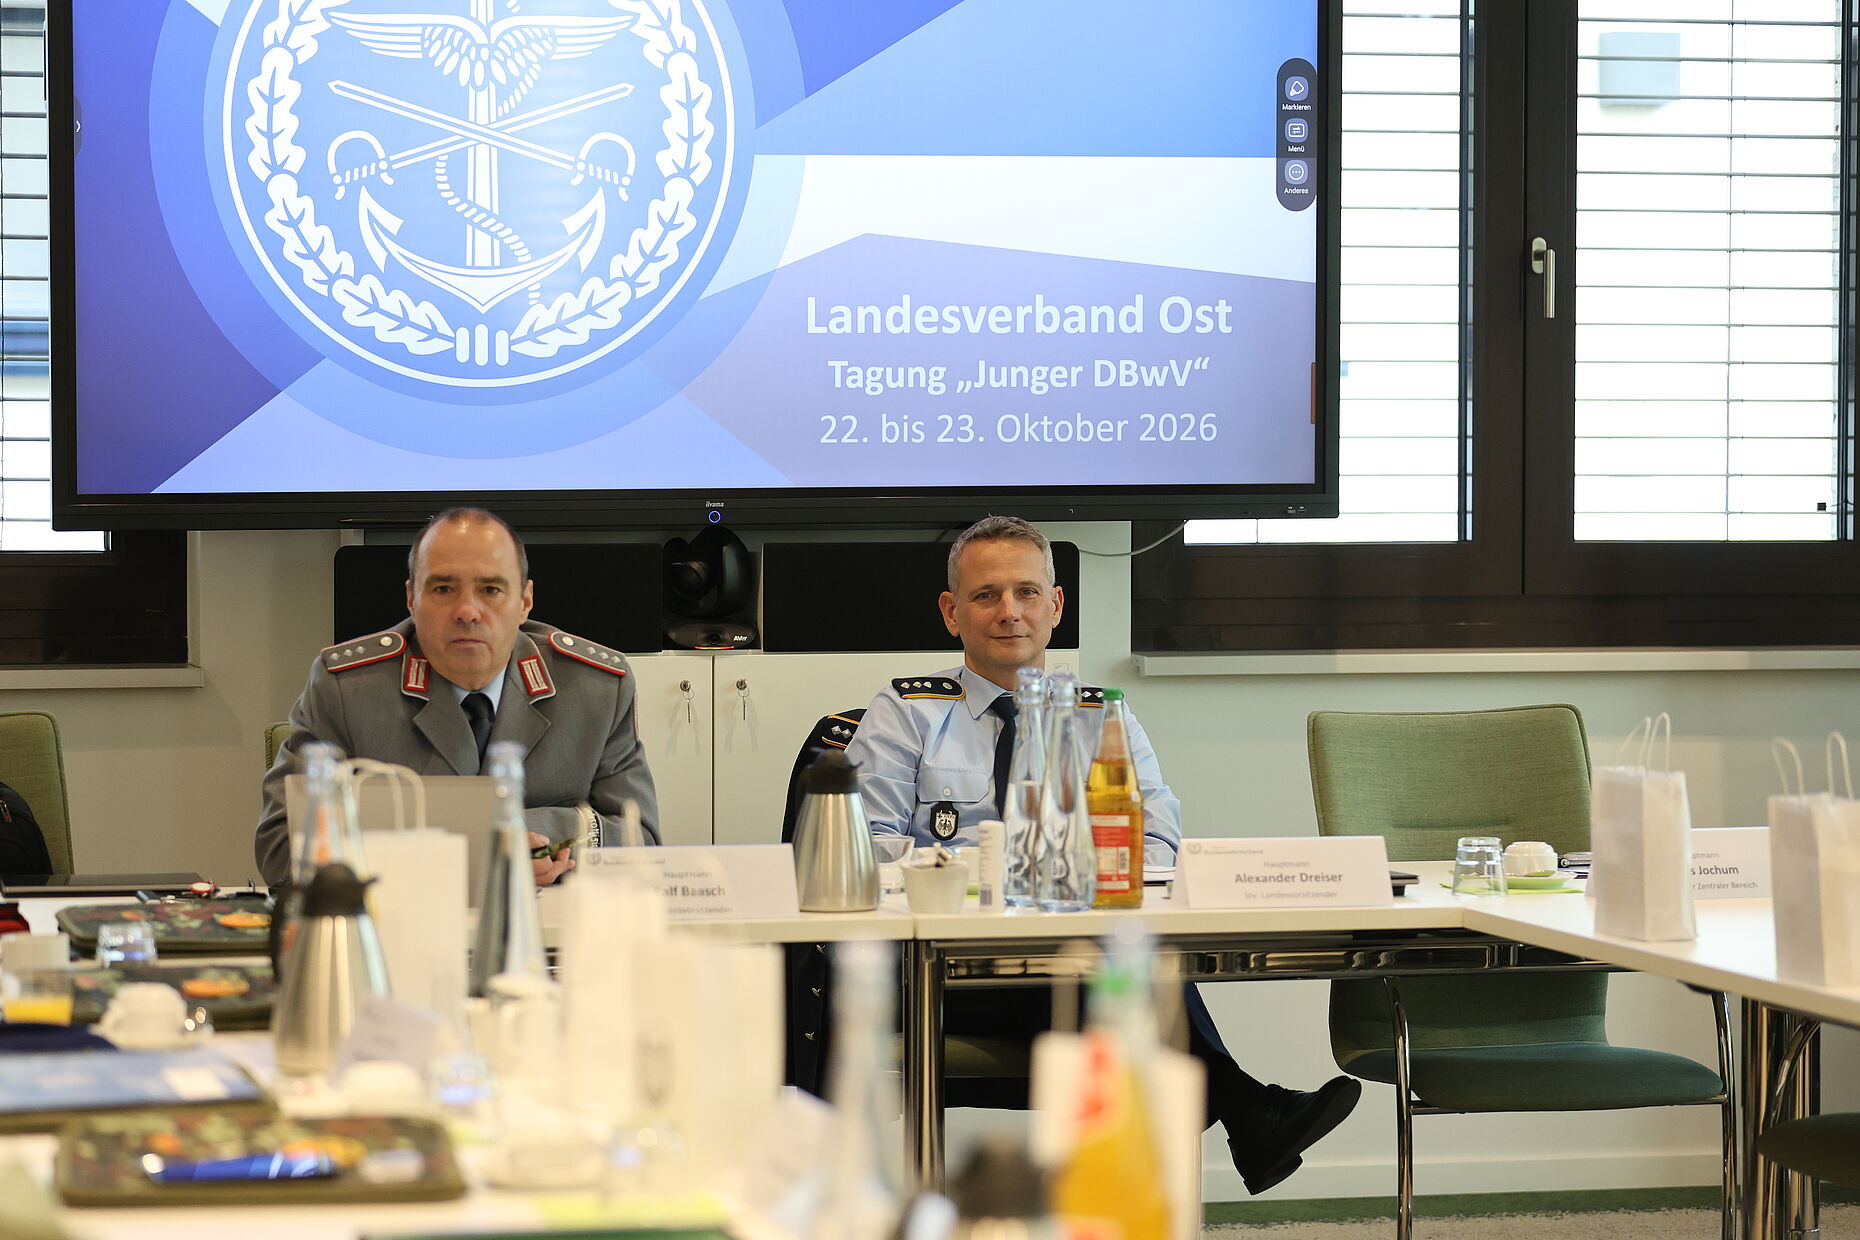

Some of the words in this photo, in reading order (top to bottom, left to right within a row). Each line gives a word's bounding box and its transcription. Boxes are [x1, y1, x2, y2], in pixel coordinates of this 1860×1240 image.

[1282, 103, 1312, 111] Markieren
[1287, 145, 1305, 153] Menü
[1283, 187, 1309, 195] Anderes
[806, 294, 1144, 334] Landesverband
[1158, 295, 1233, 334] Ost
[827, 360, 947, 396] Tagung
[956, 359, 1083, 395] „Junger
[819, 415, 869, 444] 22.
[881, 413, 926, 444] bis
[936, 414, 985, 443] 23.
[997, 412, 1129, 443] Oktober
[1139, 412, 1218, 443] 2026
[1698, 865, 1739, 875] Jochum
[1234, 873, 1296, 883] Alexander
[1299, 872, 1343, 882] Dreiser
[1730, 881, 1758, 889] Bereich
[681, 884, 726, 897] Baasch
